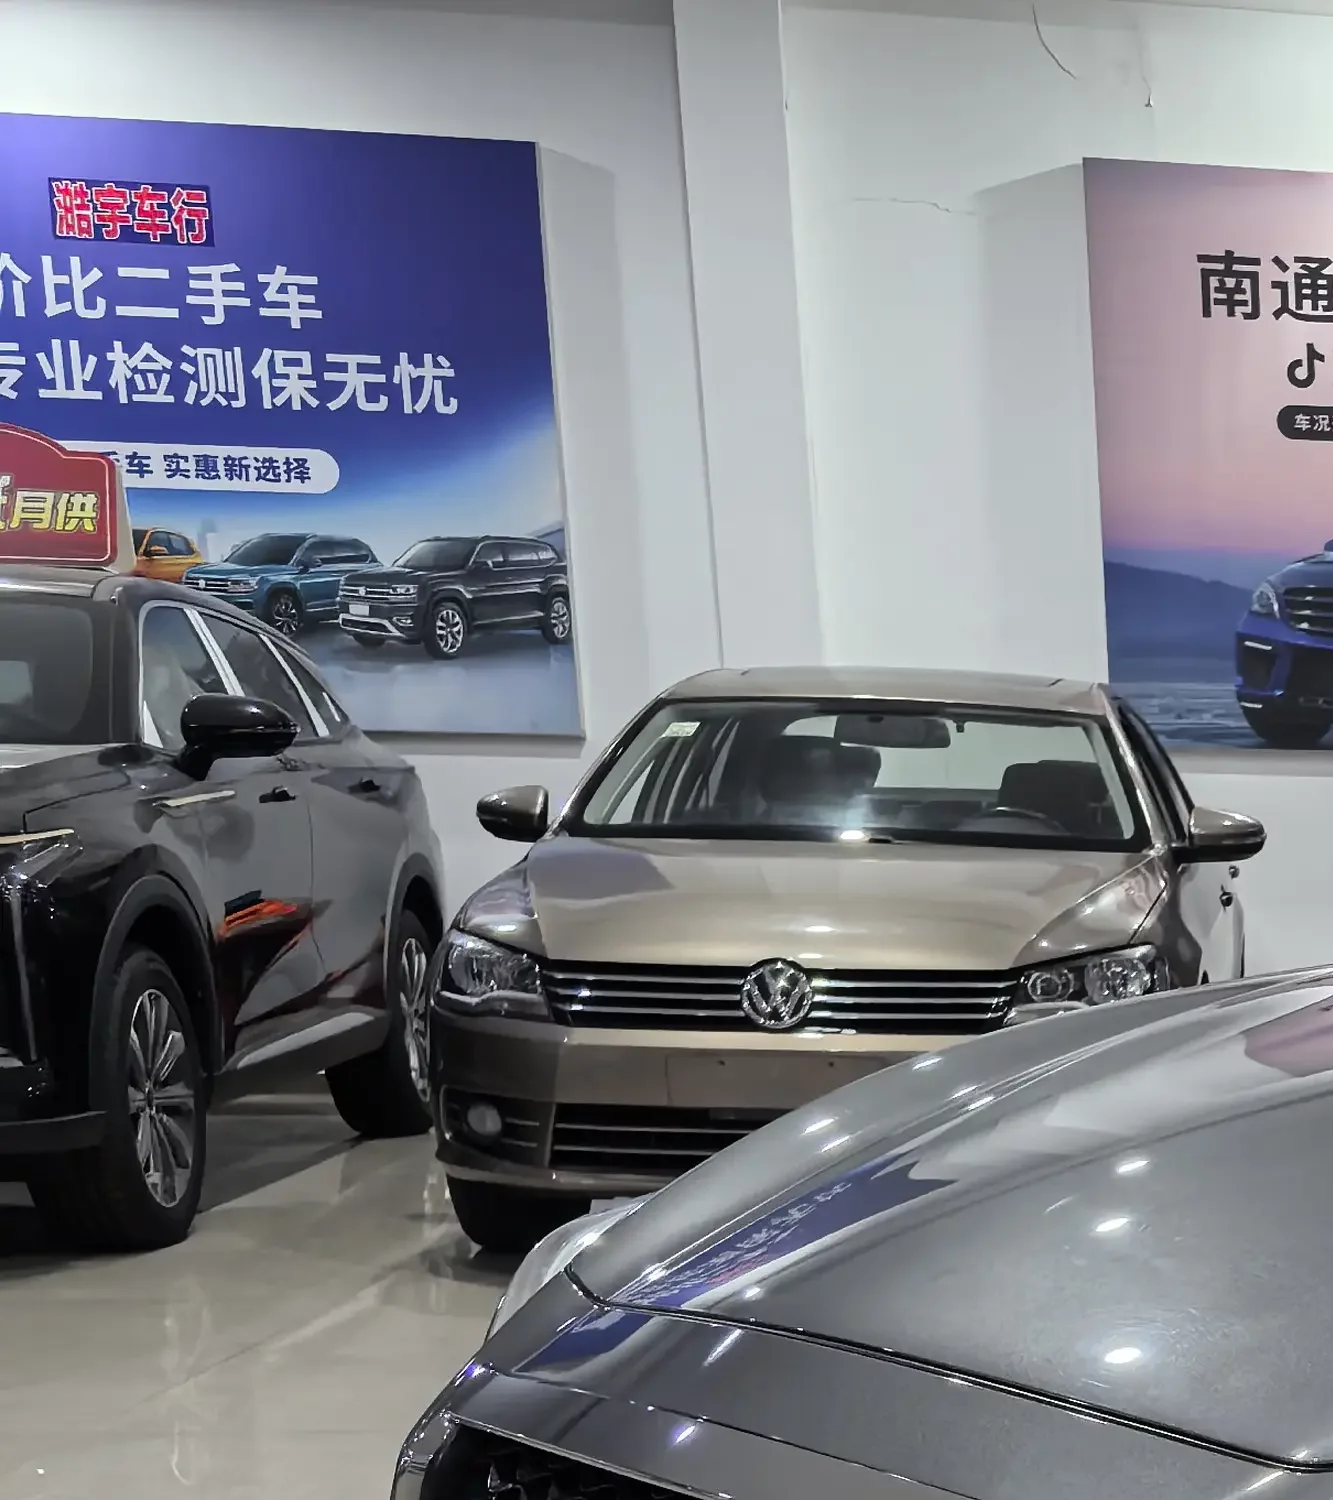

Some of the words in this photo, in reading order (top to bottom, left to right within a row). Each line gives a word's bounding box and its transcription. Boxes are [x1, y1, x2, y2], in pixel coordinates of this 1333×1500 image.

[162, 452, 312, 484] 实惠新选择
